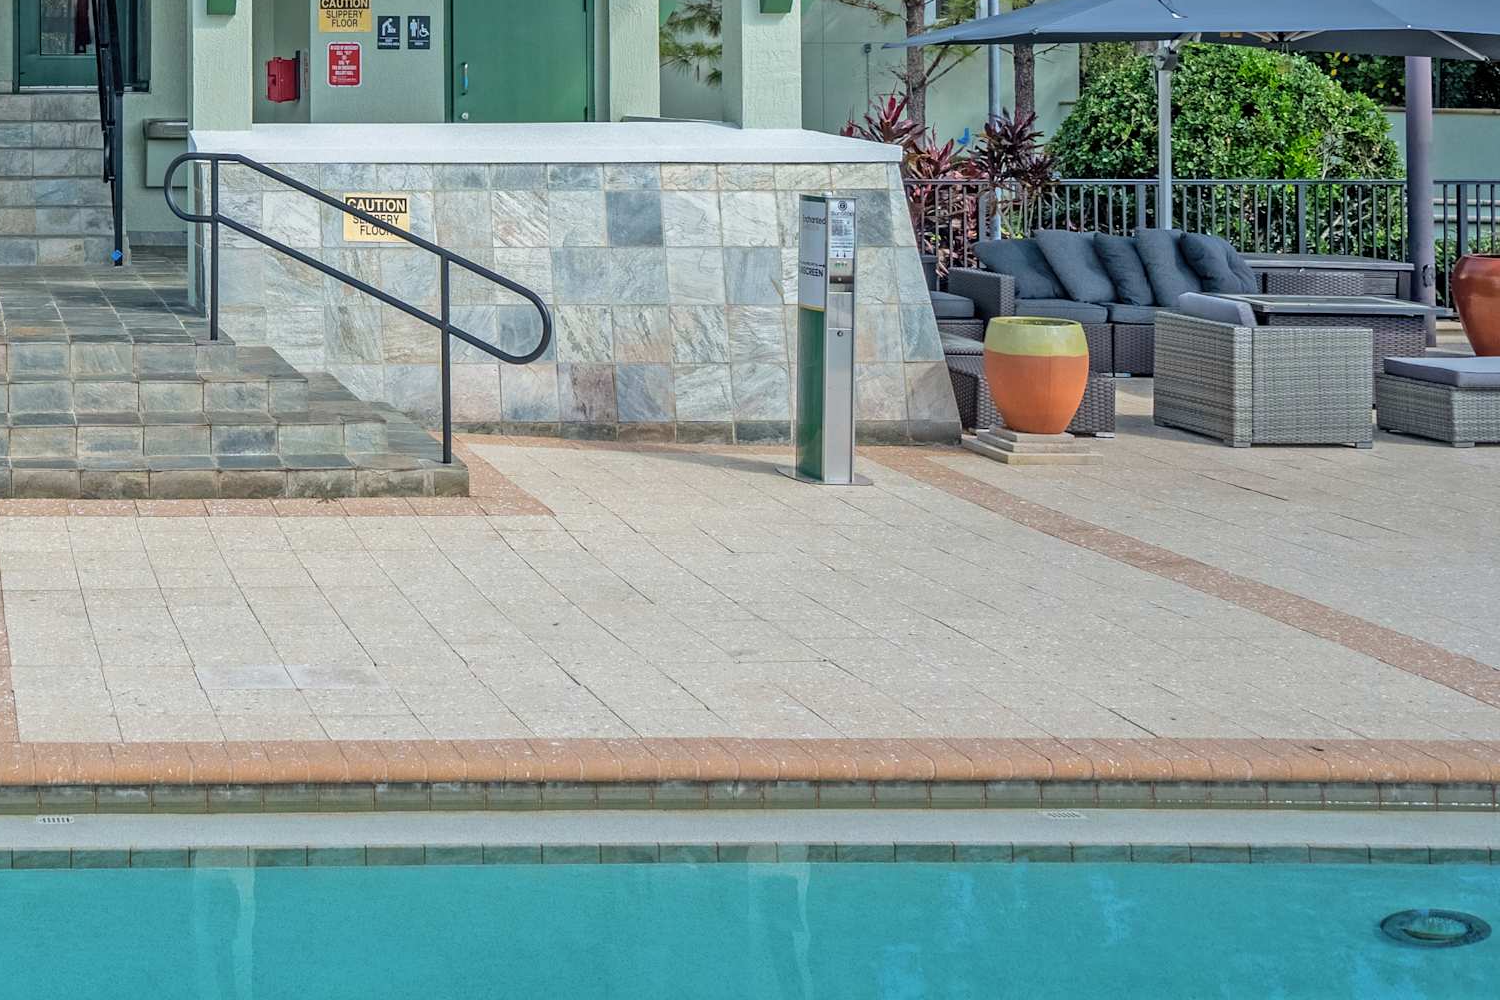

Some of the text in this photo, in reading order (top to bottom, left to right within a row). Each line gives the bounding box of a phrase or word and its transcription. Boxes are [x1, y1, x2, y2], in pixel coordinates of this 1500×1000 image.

[326, 10, 363, 18] SLIPPERY
[331, 19, 358, 27] FLOOR
[347, 199, 406, 212] CAUTION
